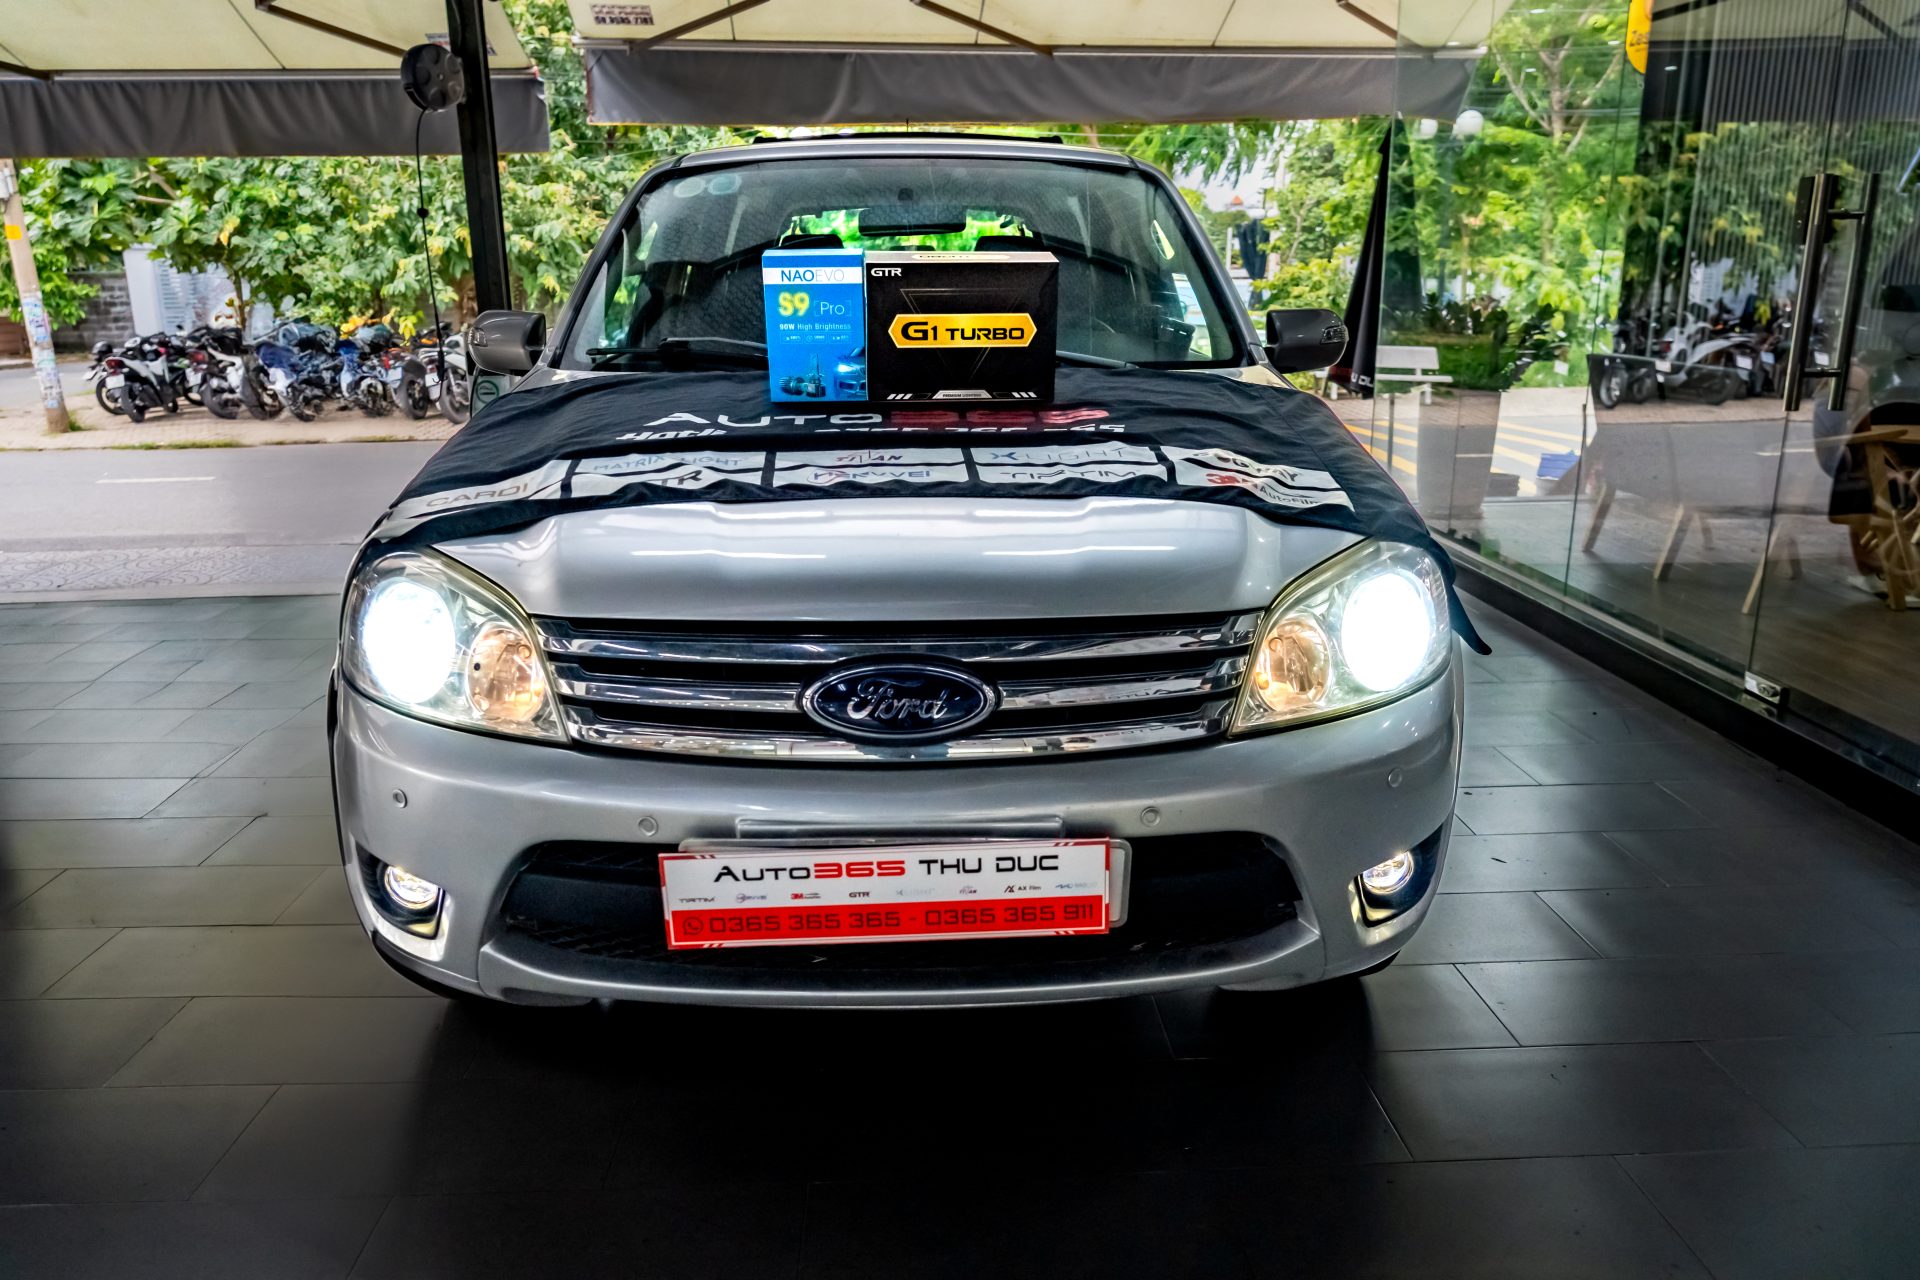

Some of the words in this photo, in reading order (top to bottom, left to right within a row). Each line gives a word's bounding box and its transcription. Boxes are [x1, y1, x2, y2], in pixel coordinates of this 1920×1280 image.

[870, 267, 902, 277] GTR
[778, 291, 810, 317] S9
[820, 301, 845, 315] Pro
[797, 323, 813, 331] High
[815, 323, 852, 331] Brightness
[901, 321, 938, 342] G1
[946, 327, 1025, 341] TURBO
[847, 677, 950, 720] Ford
[918, 857, 982, 875] THU
[996, 854, 1059, 873] DUC
[848, 891, 871, 899] GTR
[709, 915, 782, 933] 0365
[788, 913, 841, 931] 365
[848, 911, 900, 927] 365
[925, 907, 996, 926] 0365
[1003, 905, 1056, 923] 365
[1063, 903, 1094, 921] 911
